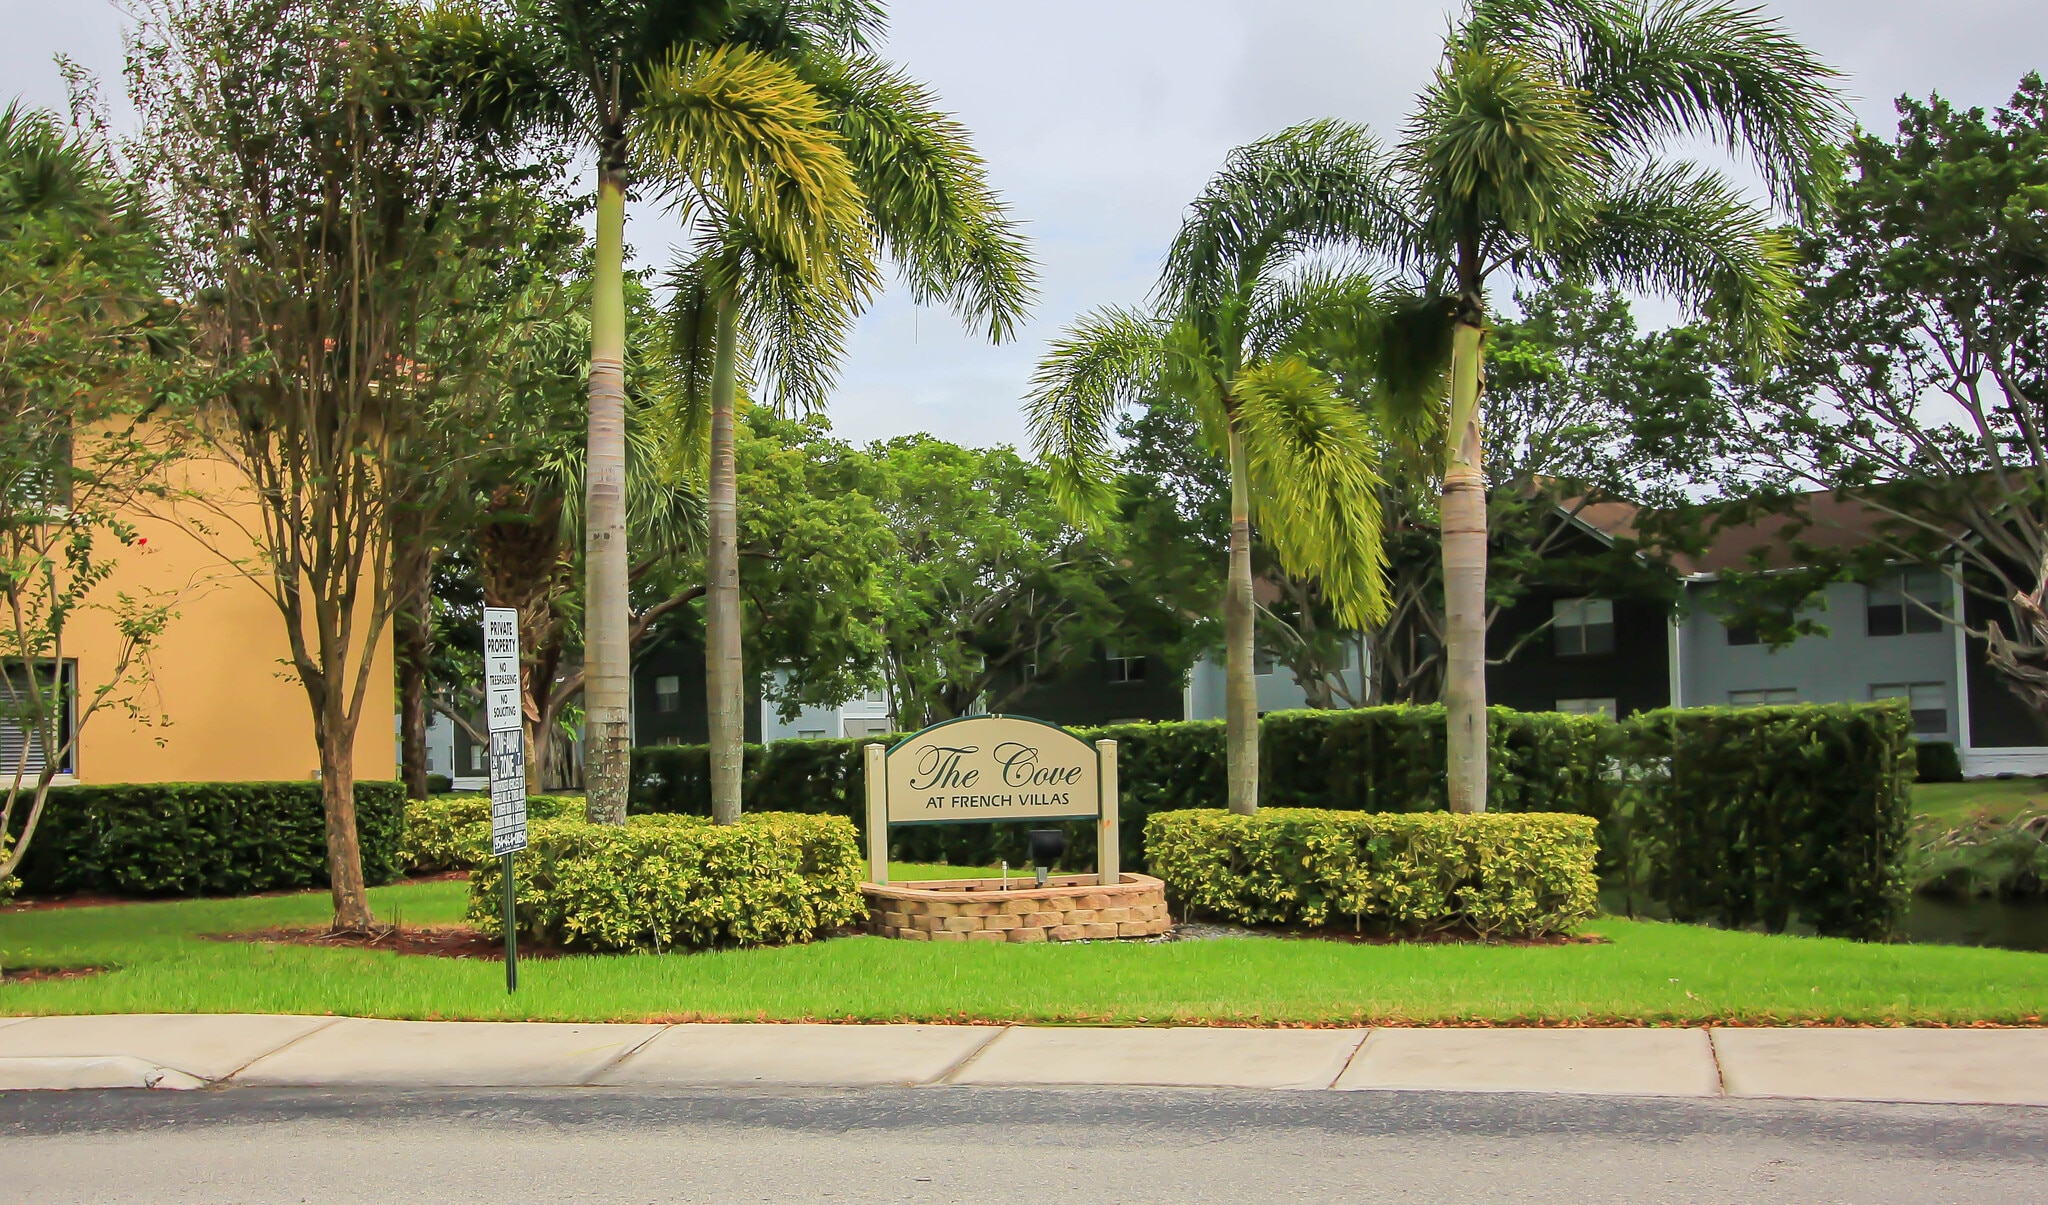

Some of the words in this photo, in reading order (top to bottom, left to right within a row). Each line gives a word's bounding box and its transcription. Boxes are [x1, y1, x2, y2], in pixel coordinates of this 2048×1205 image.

[490, 621, 513, 636] PRIVATE
[487, 638, 516, 653] PROPERTY
[499, 662, 507, 673] NO
[489, 674, 518, 686] TRESPASSING
[500, 694, 508, 705] NO
[493, 706, 517, 718] SOLICITING
[500, 754, 515, 778] ZONE
[909, 744, 980, 791] The
[993, 742, 1083, 788] Cove
[925, 796, 945, 809] AT
[951, 794, 1012, 808] FRENCH
[1018, 793, 1069, 806] VILLAS
